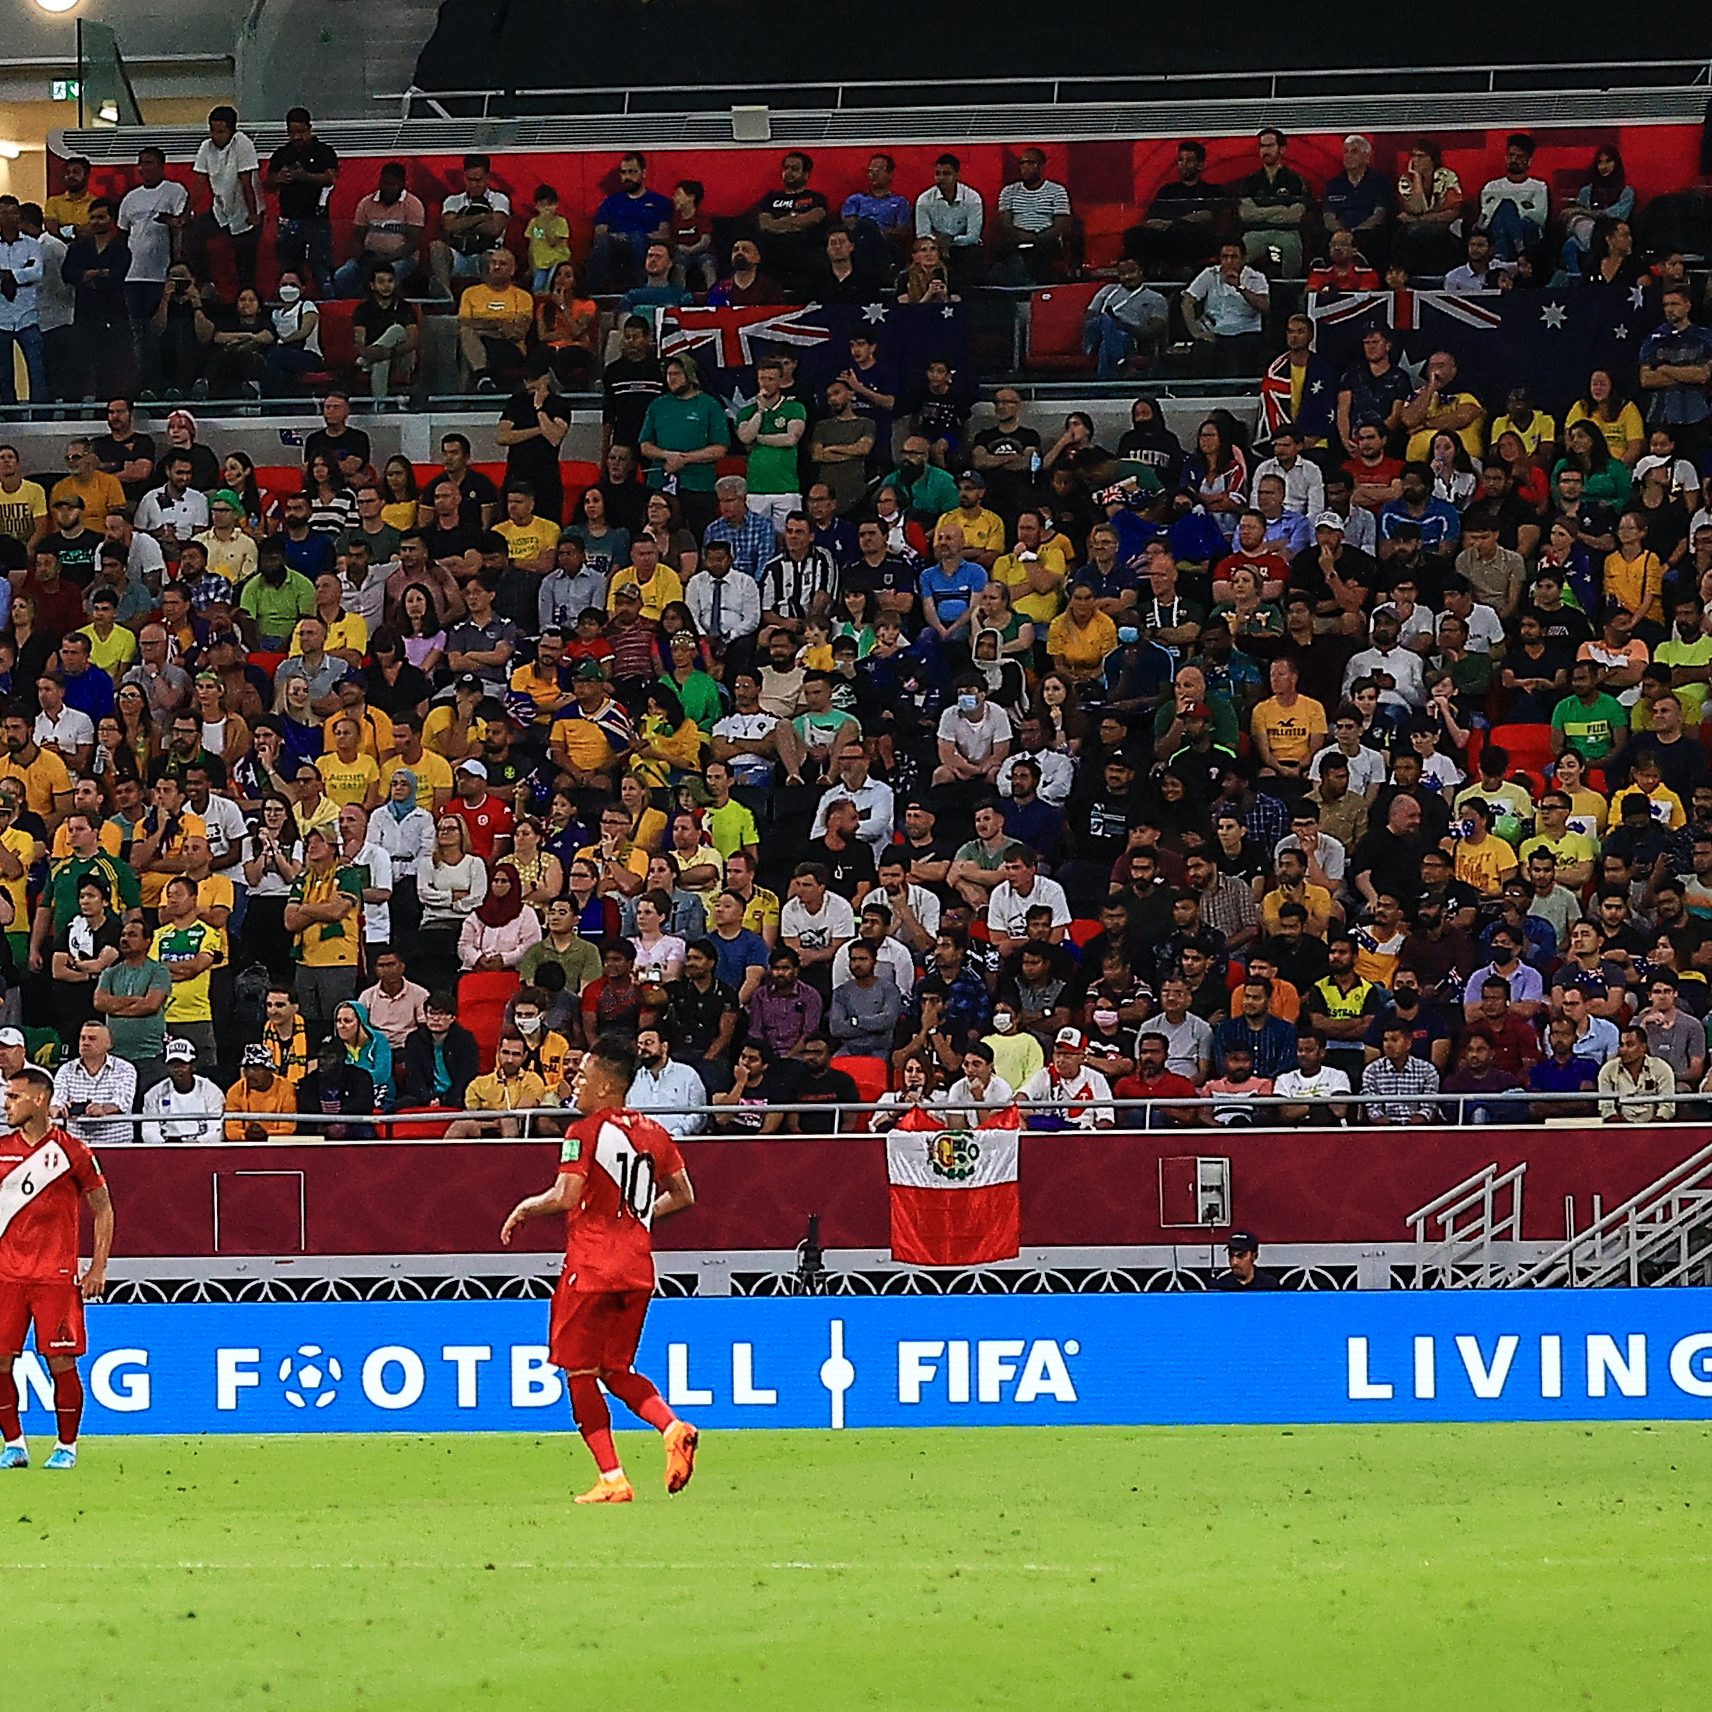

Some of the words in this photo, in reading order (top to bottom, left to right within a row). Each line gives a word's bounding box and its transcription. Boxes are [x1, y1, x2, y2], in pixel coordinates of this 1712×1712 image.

[21, 1172, 35, 1196] 6
[615, 1152, 657, 1220] 10
[896, 1339, 1082, 1404] FIFA
[1346, 1333, 1712, 1401] LIVING
